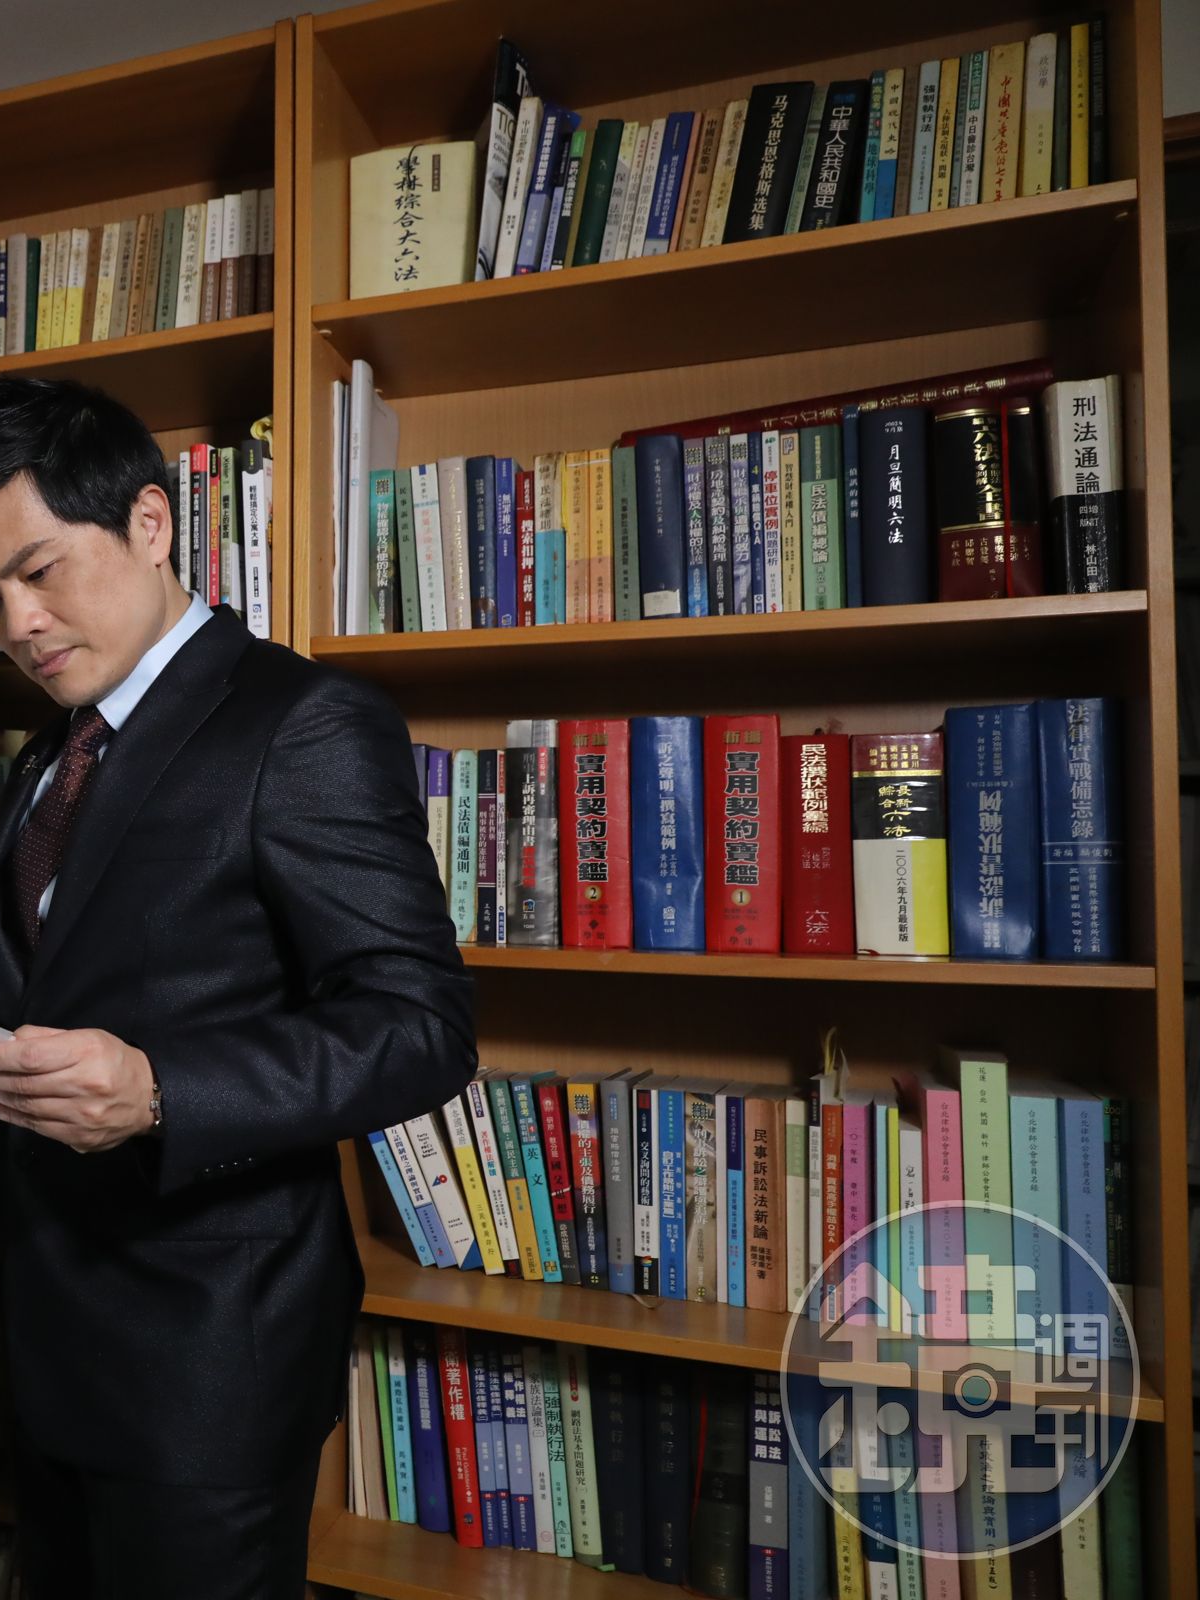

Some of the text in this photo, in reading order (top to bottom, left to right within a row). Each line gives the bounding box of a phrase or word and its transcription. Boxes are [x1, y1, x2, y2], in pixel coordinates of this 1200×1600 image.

[920, 84, 936, 133] 強制執行法
[747, 94, 788, 231] 马克思恩格斯选集
[813, 105, 853, 209] 中華人民共和國史
[1072, 395, 1100, 494] 刑法通論
[811, 484, 828, 564] 民法債編總論
[887, 444, 905, 544] 月旦簡明六法
[521, 520, 534, 570] 搜索扣押
[1084, 544, 1098, 577] 林山田
[522, 774, 536, 847] 上訴再審理由書
[1067, 703, 1095, 839] 法律實戰備忘錄
[456, 796, 471, 874] 民法債編通則
[574, 754, 609, 883] 實用契約寶鑑
[724, 751, 760, 886] 實用契約寶鑑
[978, 789, 1004, 918] 訴訟書狀範例
[526, 1147, 544, 1186] 英文
[940, 1102, 951, 1182] 台北律師公會會員名錄
[981, 1133, 989, 1148] 新竹
[1027, 1109, 1040, 1193] 台北律師公會會員名錄
[1079, 1110, 1091, 1195] 台北律師公會會員名錄
[752, 1128, 769, 1241] 民事訴訟法新論
[545, 1396, 566, 1462] 強制執行法
